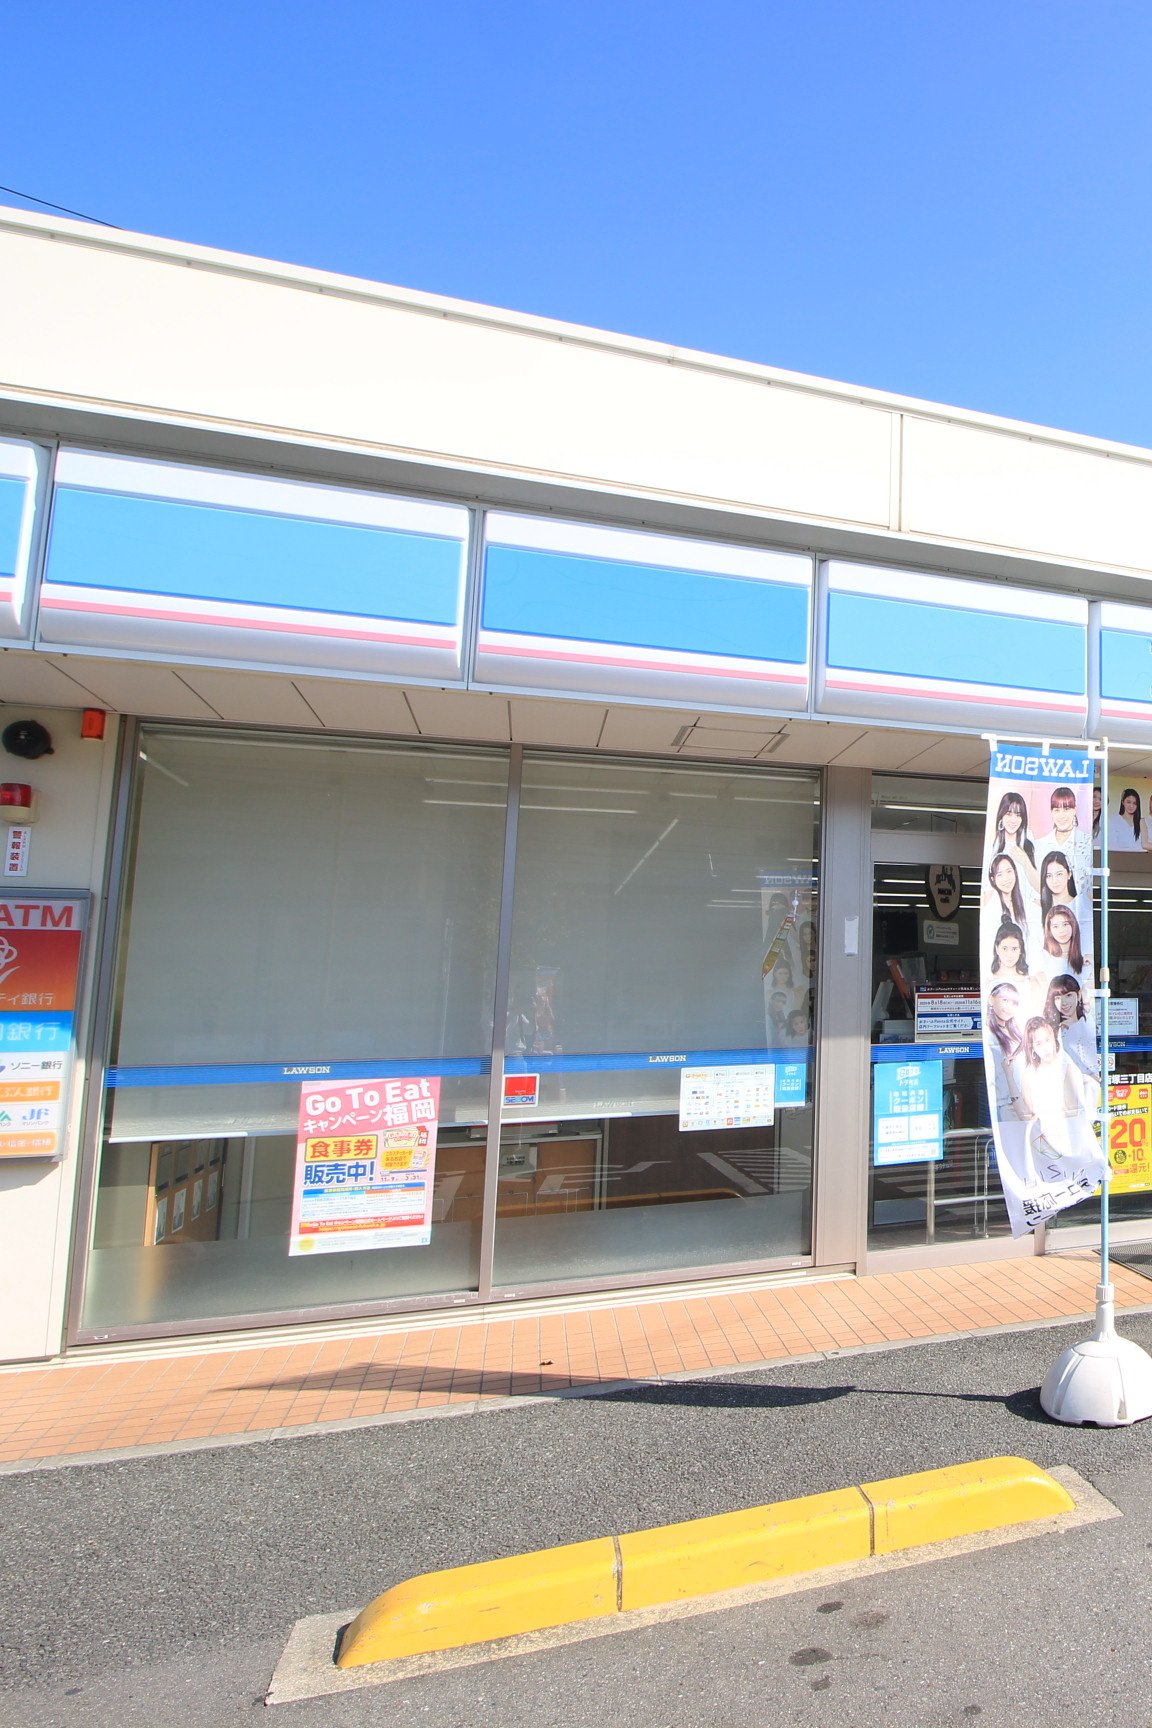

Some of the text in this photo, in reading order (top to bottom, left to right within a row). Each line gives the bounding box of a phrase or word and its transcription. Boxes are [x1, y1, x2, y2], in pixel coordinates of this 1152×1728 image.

[0, 904, 73, 927] ATM
[0, 1021, 61, 1040] 銀行
[11, 1060, 63, 1071] ソニー銀行
[283, 1066, 330, 1075] LAWSON
[305, 1078, 431, 1116] Go To Eat
[310, 1138, 373, 1158] 食事券
[304, 1161, 375, 1185] 販売中!
